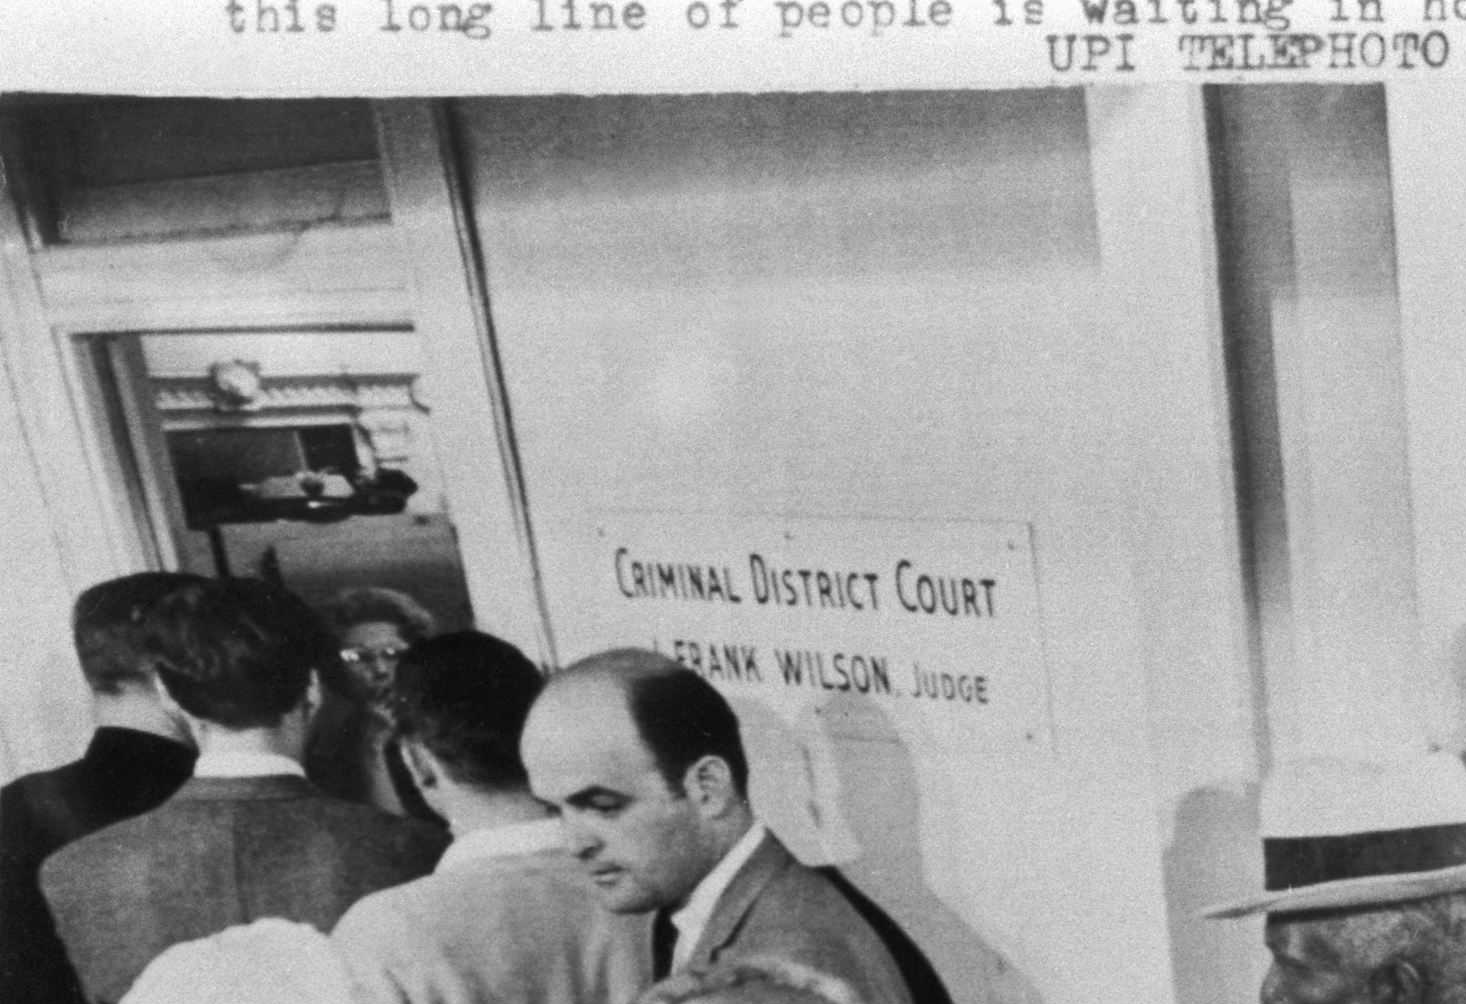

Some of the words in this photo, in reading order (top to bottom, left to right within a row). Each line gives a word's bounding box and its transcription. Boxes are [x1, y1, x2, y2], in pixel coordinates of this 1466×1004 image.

[615, 547, 742, 604] CRIMINAL
[750, 553, 880, 611] DISTRICT
[896, 559, 996, 617] COURT
[911, 661, 990, 704] JUDGE
